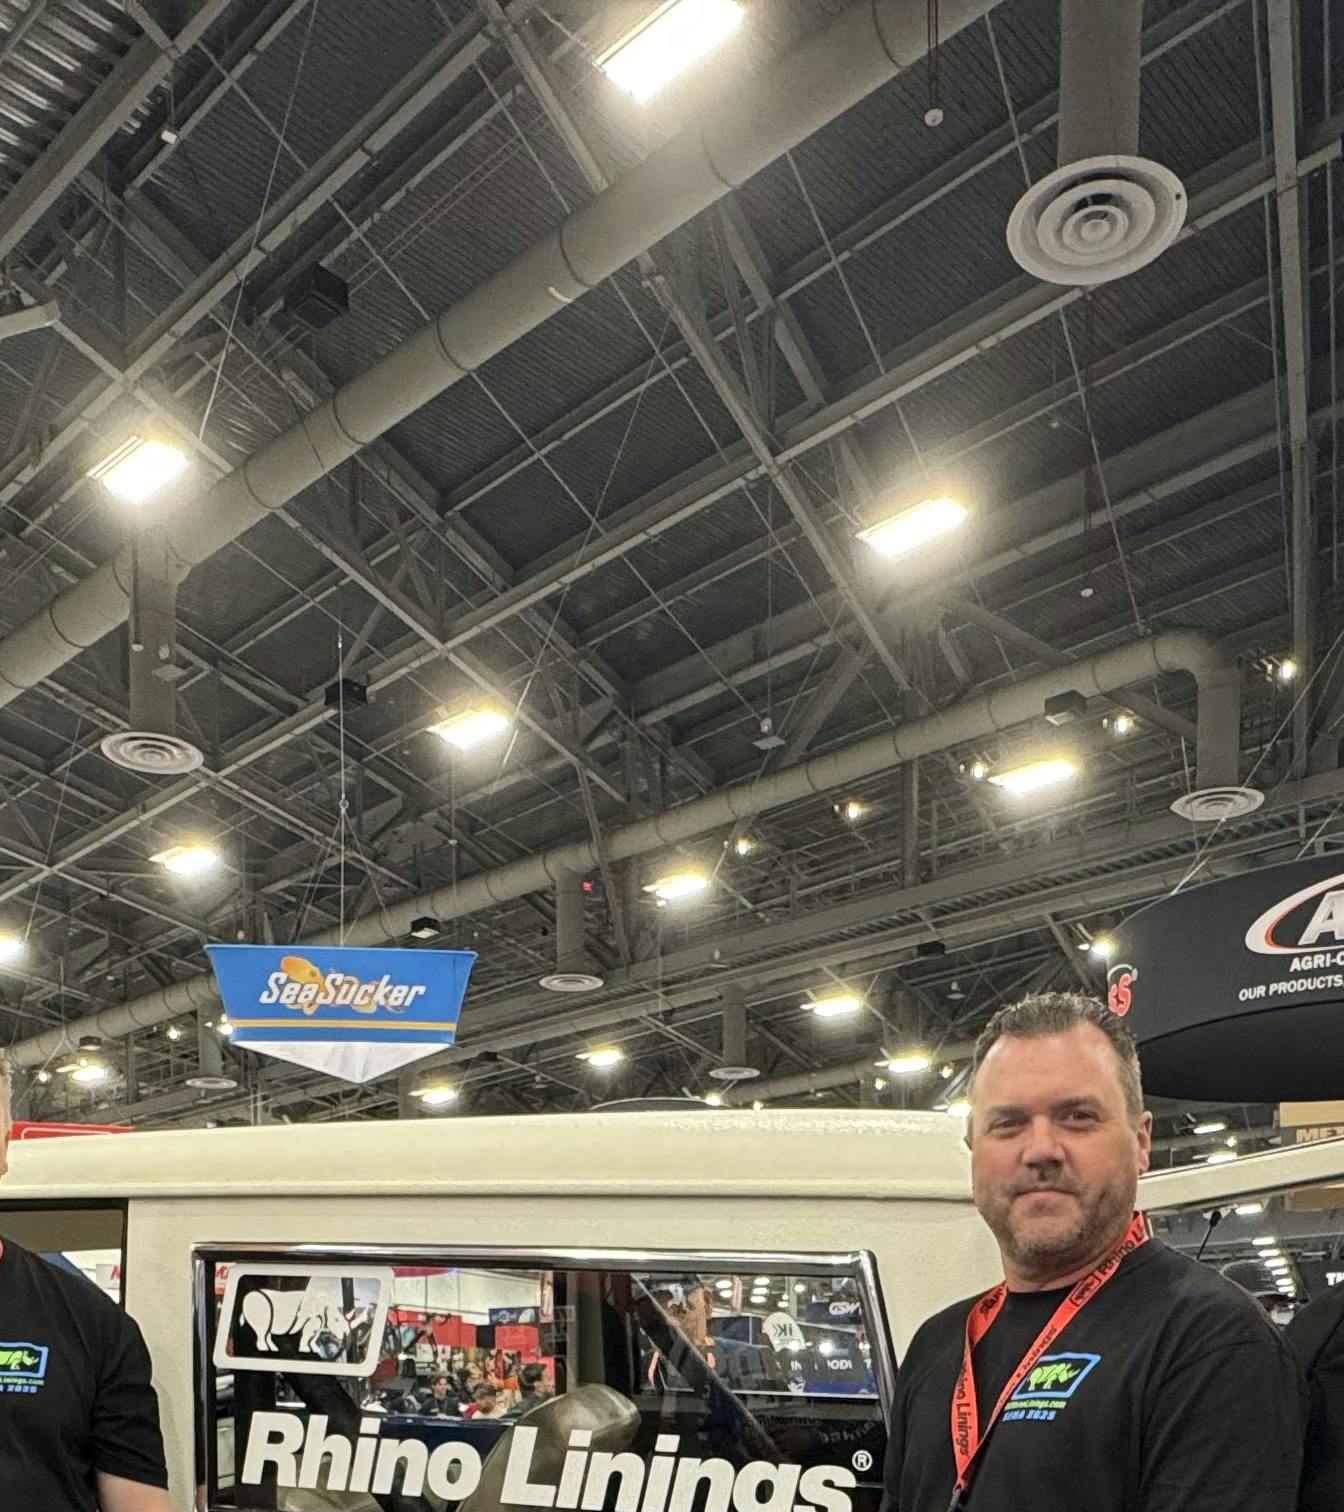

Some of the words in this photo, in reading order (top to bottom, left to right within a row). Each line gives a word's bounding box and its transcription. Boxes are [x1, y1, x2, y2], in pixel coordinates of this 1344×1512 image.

[258, 971, 428, 1007] SeaSucker
[1238, 985, 1266, 1001] OUR
[955, 1402, 972, 1457] Linings
[241, 1410, 483, 1501] Rhino
